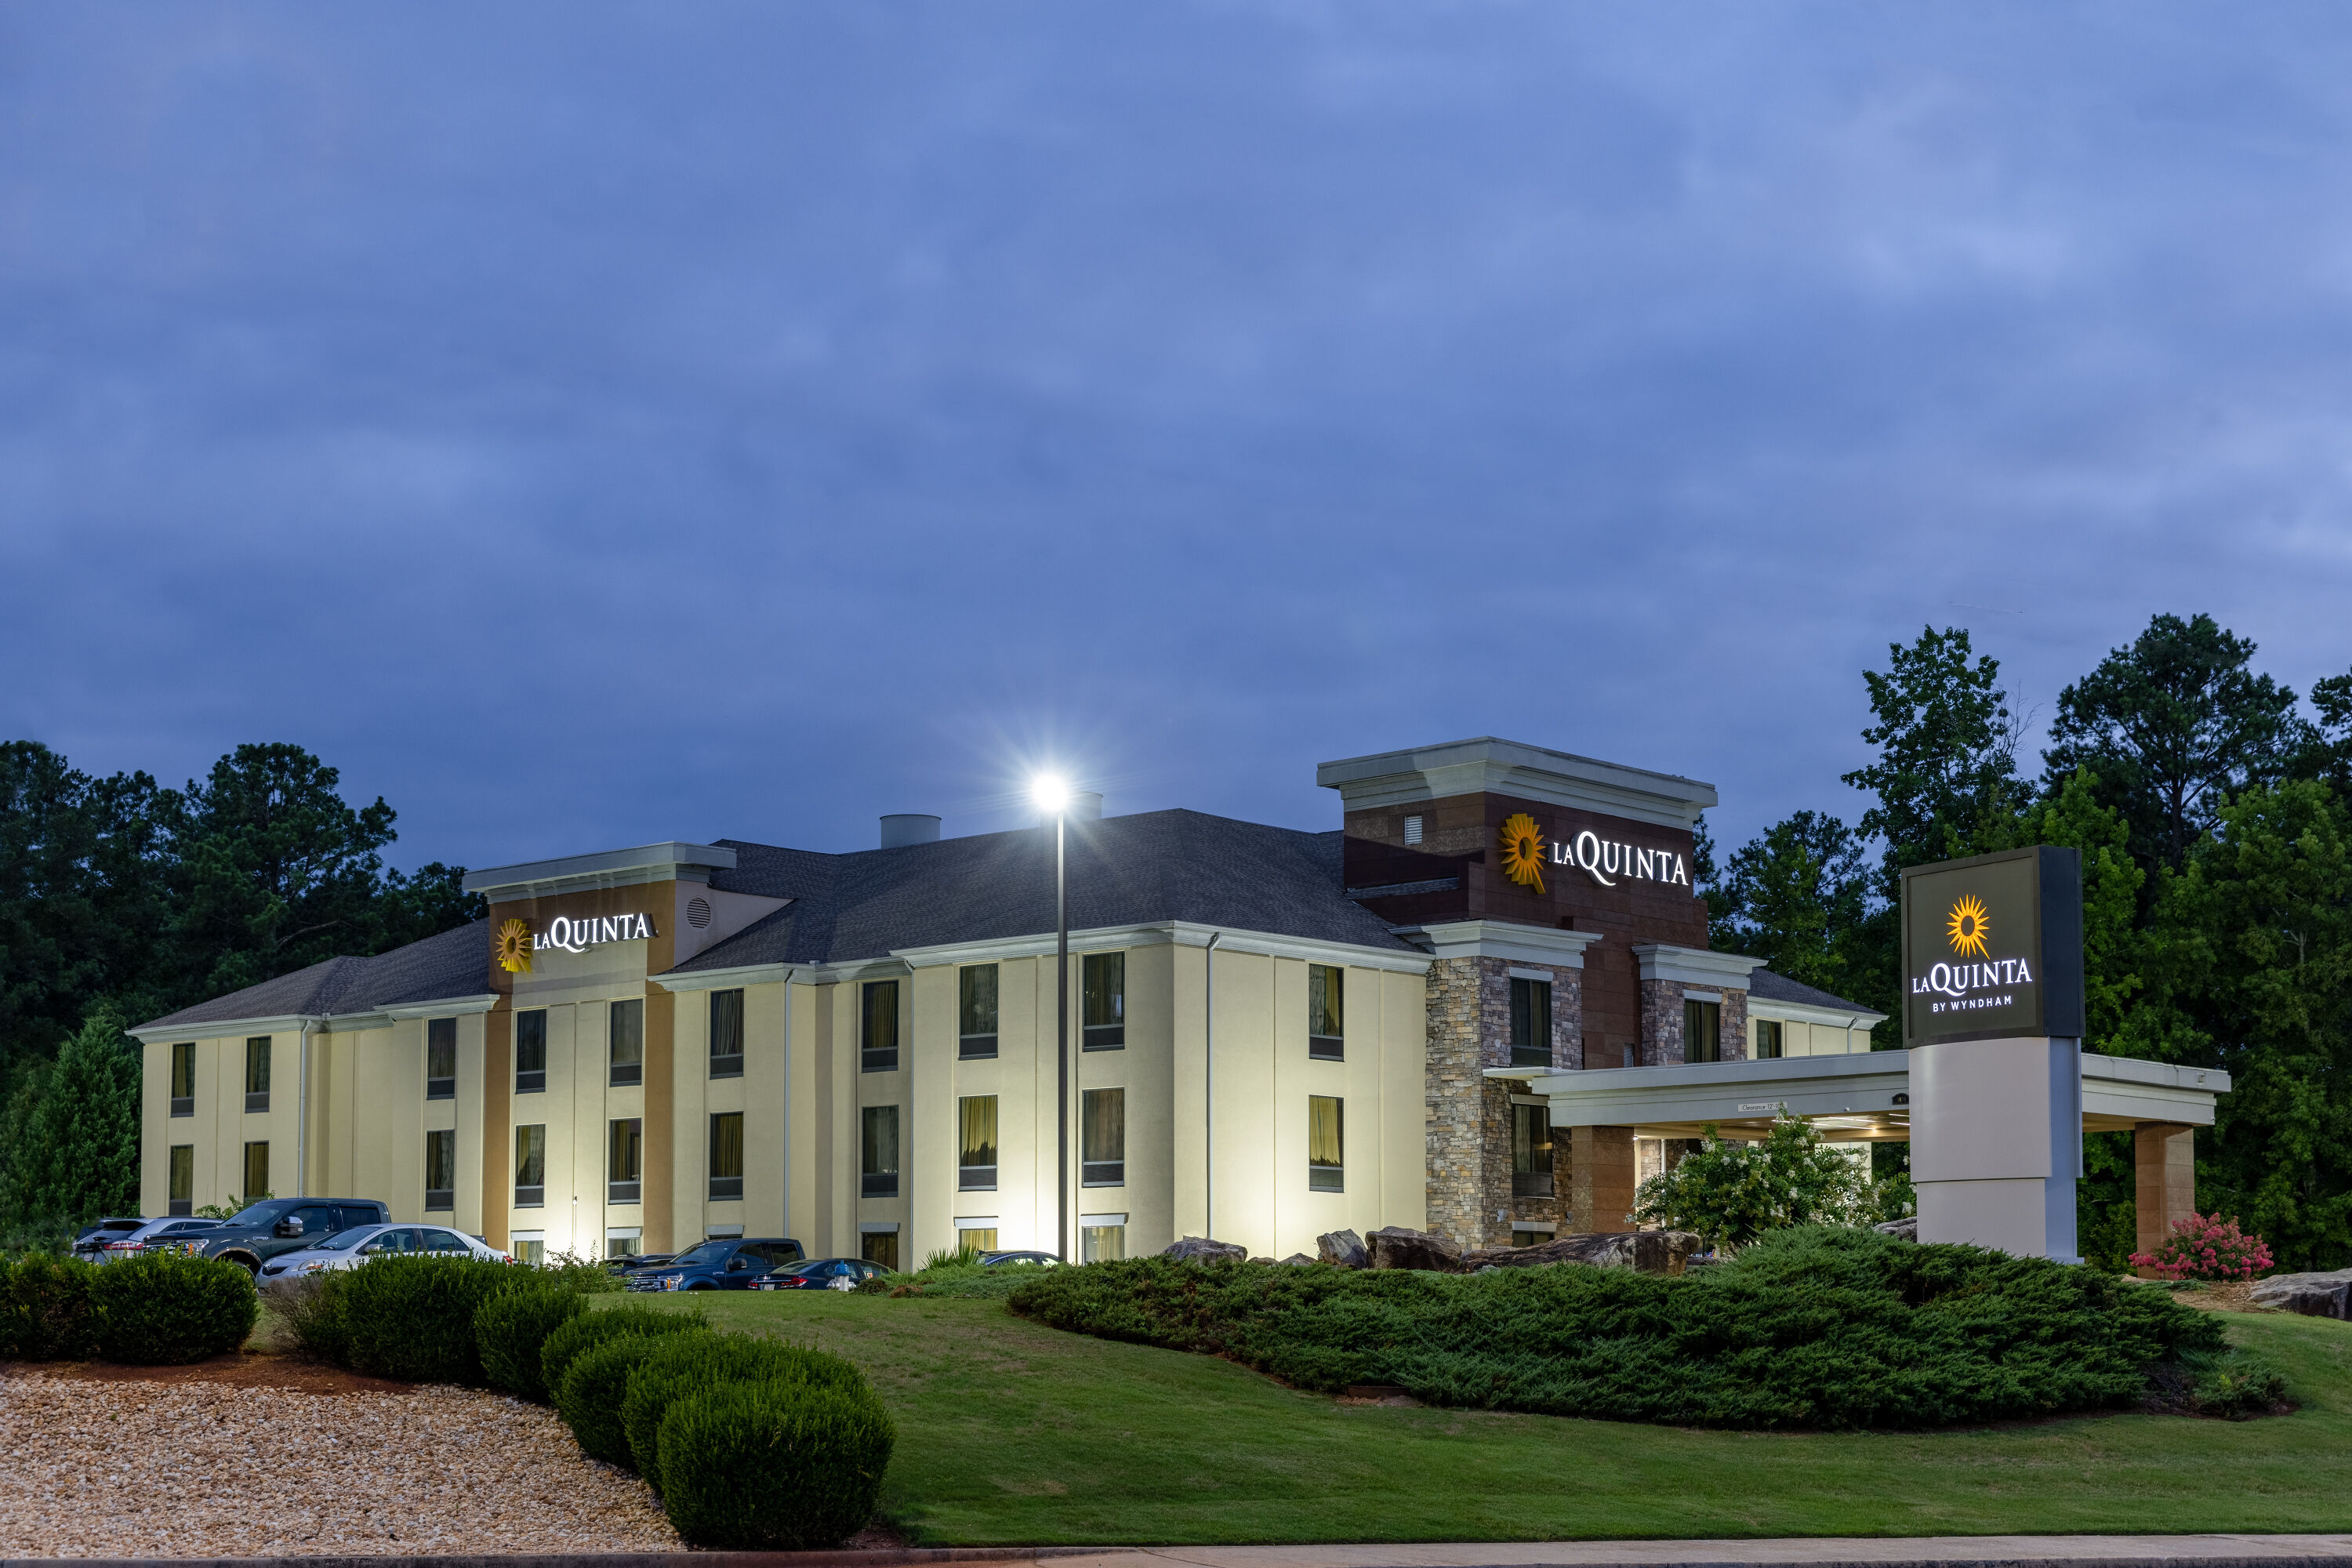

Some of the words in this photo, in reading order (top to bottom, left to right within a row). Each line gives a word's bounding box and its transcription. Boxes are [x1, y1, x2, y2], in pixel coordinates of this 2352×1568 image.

[1553, 842, 1576, 866] LA
[1576, 830, 1689, 887] QUINTA
[533, 932, 551, 950] LA
[550, 912, 650, 953] QUINTA
[1912, 976, 1931, 993] LA
[1930, 957, 2033, 996] QUINTA
[1933, 1002, 1946, 1012] BY
[1951, 995, 2012, 1011] WYNDHAM
